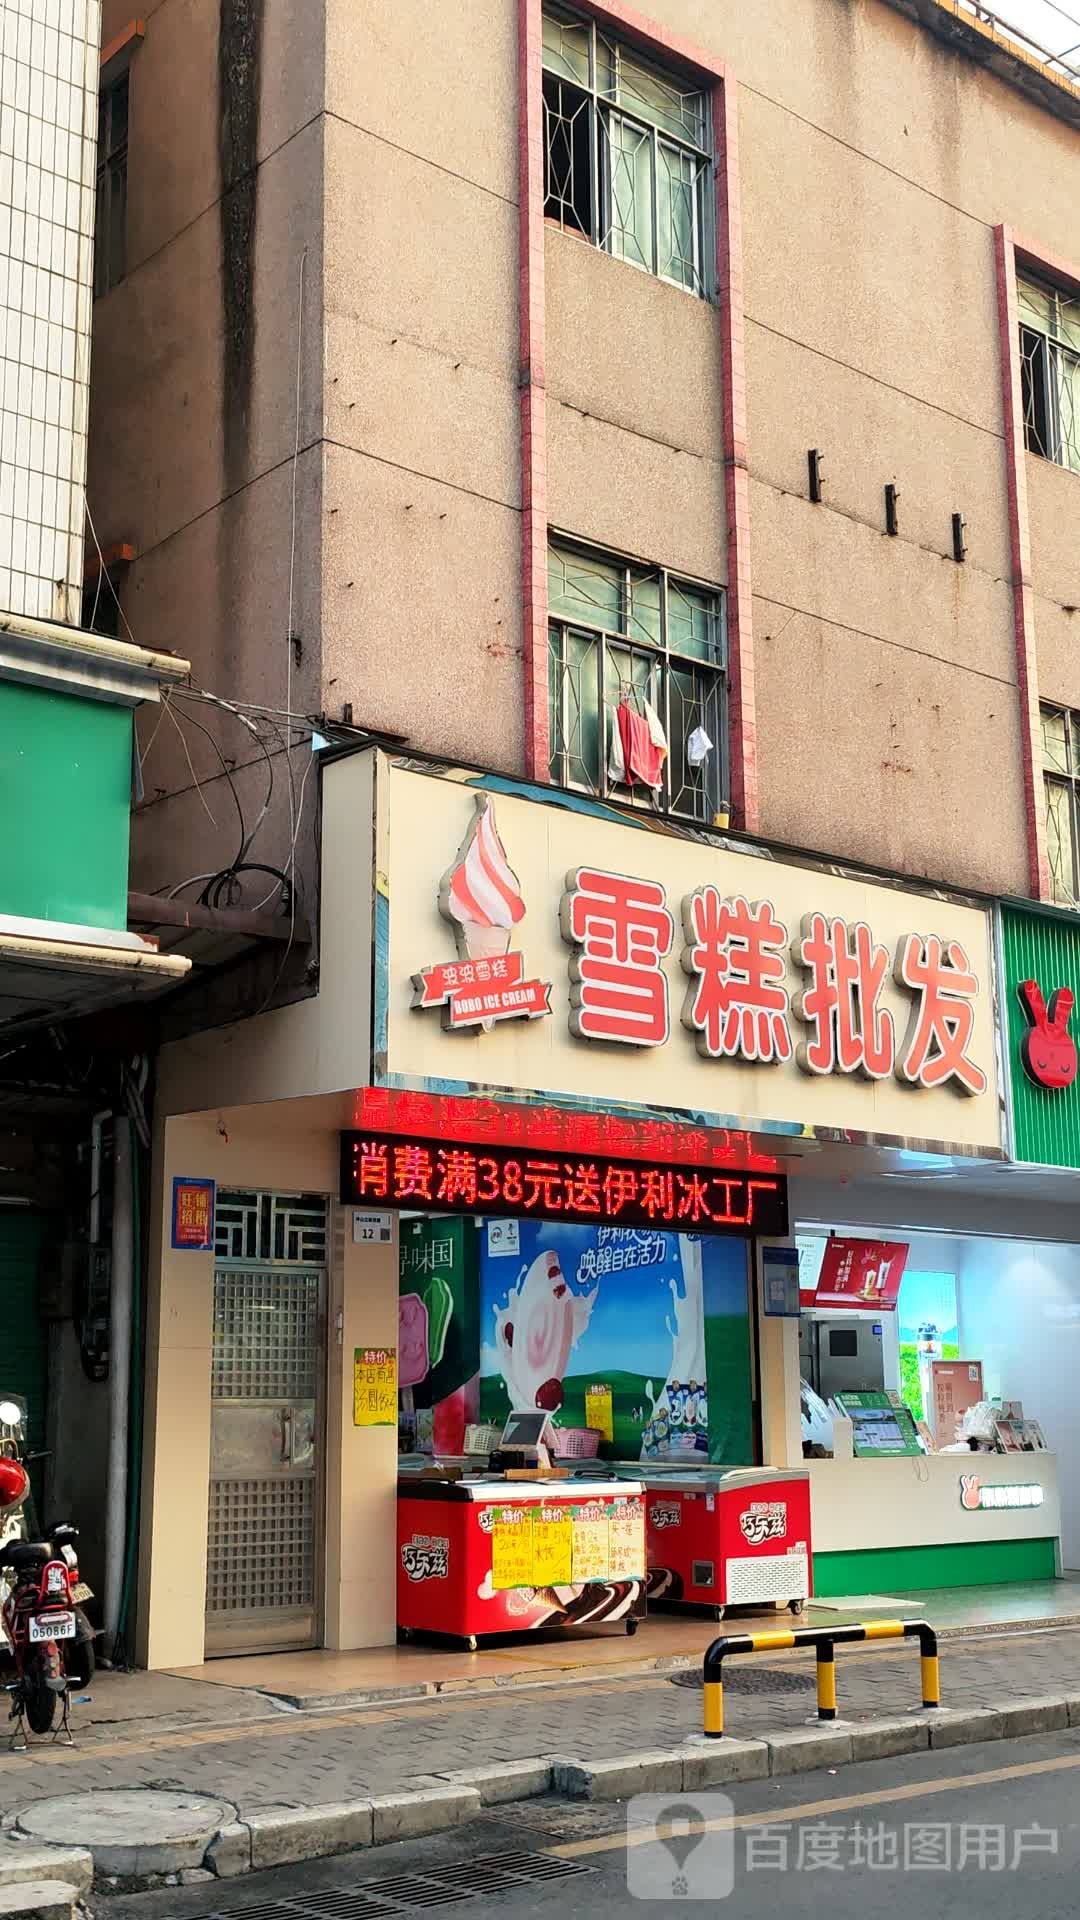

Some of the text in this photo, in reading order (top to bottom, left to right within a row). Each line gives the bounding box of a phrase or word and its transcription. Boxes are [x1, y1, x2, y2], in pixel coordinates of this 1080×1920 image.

[441, 959, 509, 986] 波波雪糕
[570, 867, 987, 1097] 雪糕批发
[454, 988, 536, 1015] BOBO ICE CREAM
[354, 1141, 777, 1226] 消费满38元送伊利冰工厂
[362, 1228, 375, 1239] 12
[576, 1235, 666, 1283] 唤醒自在活力
[365, 1350, 387, 1364] 特价
[591, 1385, 606, 1395] 特价
[502, 1509, 524, 1523] 特价
[541, 1508, 563, 1521] 特价
[579, 1507, 600, 1520] 特价
[616, 1506, 637, 1519] 特价
[741, 1511, 786, 1545] 巧乐兹
[402, 1543, 448, 1581] 巧乐兹
[32, 1624, 73, 1639] 05086F
